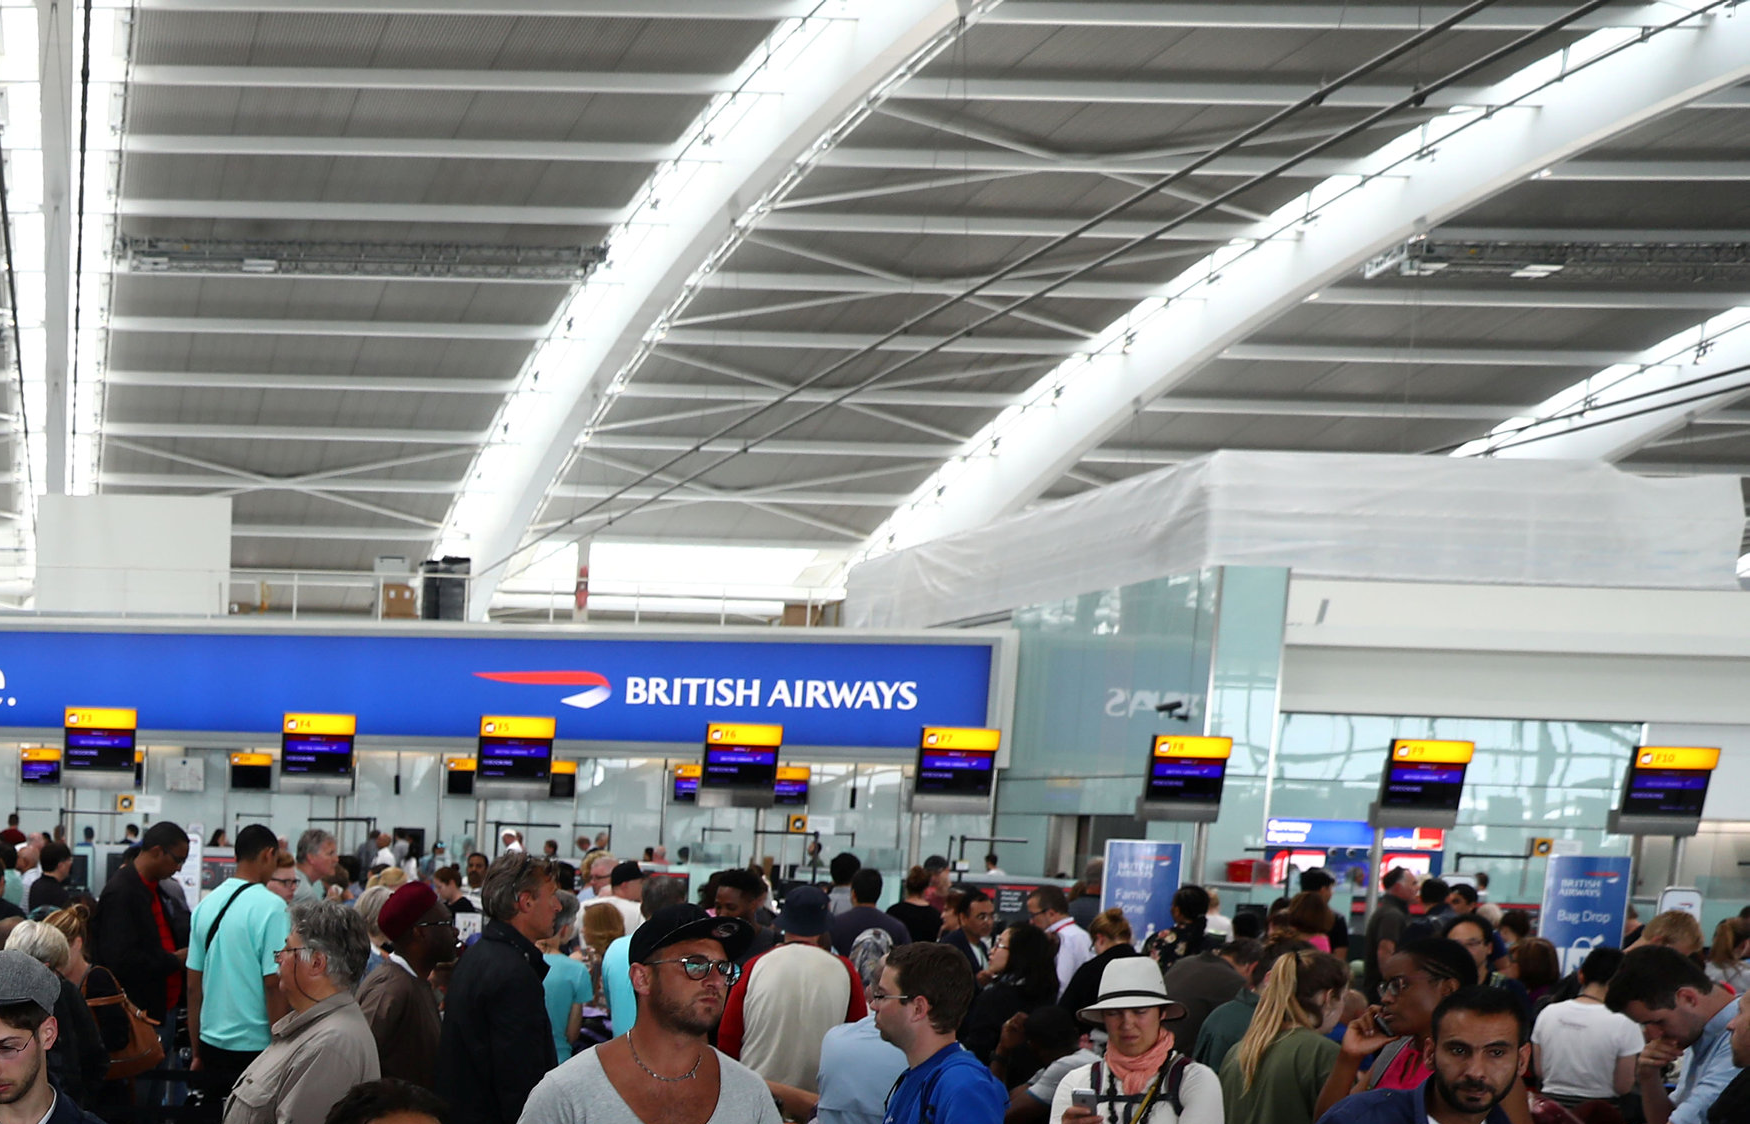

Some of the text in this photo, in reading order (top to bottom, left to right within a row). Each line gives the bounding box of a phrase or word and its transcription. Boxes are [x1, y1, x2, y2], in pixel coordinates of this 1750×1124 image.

[625, 676, 918, 710] BRITISH AIRWAYS
[300, 720, 311, 729] F4
[497, 722, 510, 732] F5
[940, 735, 953, 744] F7
[1412, 746, 1425, 756] F9
[1655, 753, 1675, 763] F10
[1560, 878, 1602, 888] BRITISH
[1114, 888, 1152, 903] Family
[1557, 887, 1602, 898] AIRWAYS
[1114, 901, 1146, 914] Zone
[1556, 908, 1612, 925] Bag Drop
